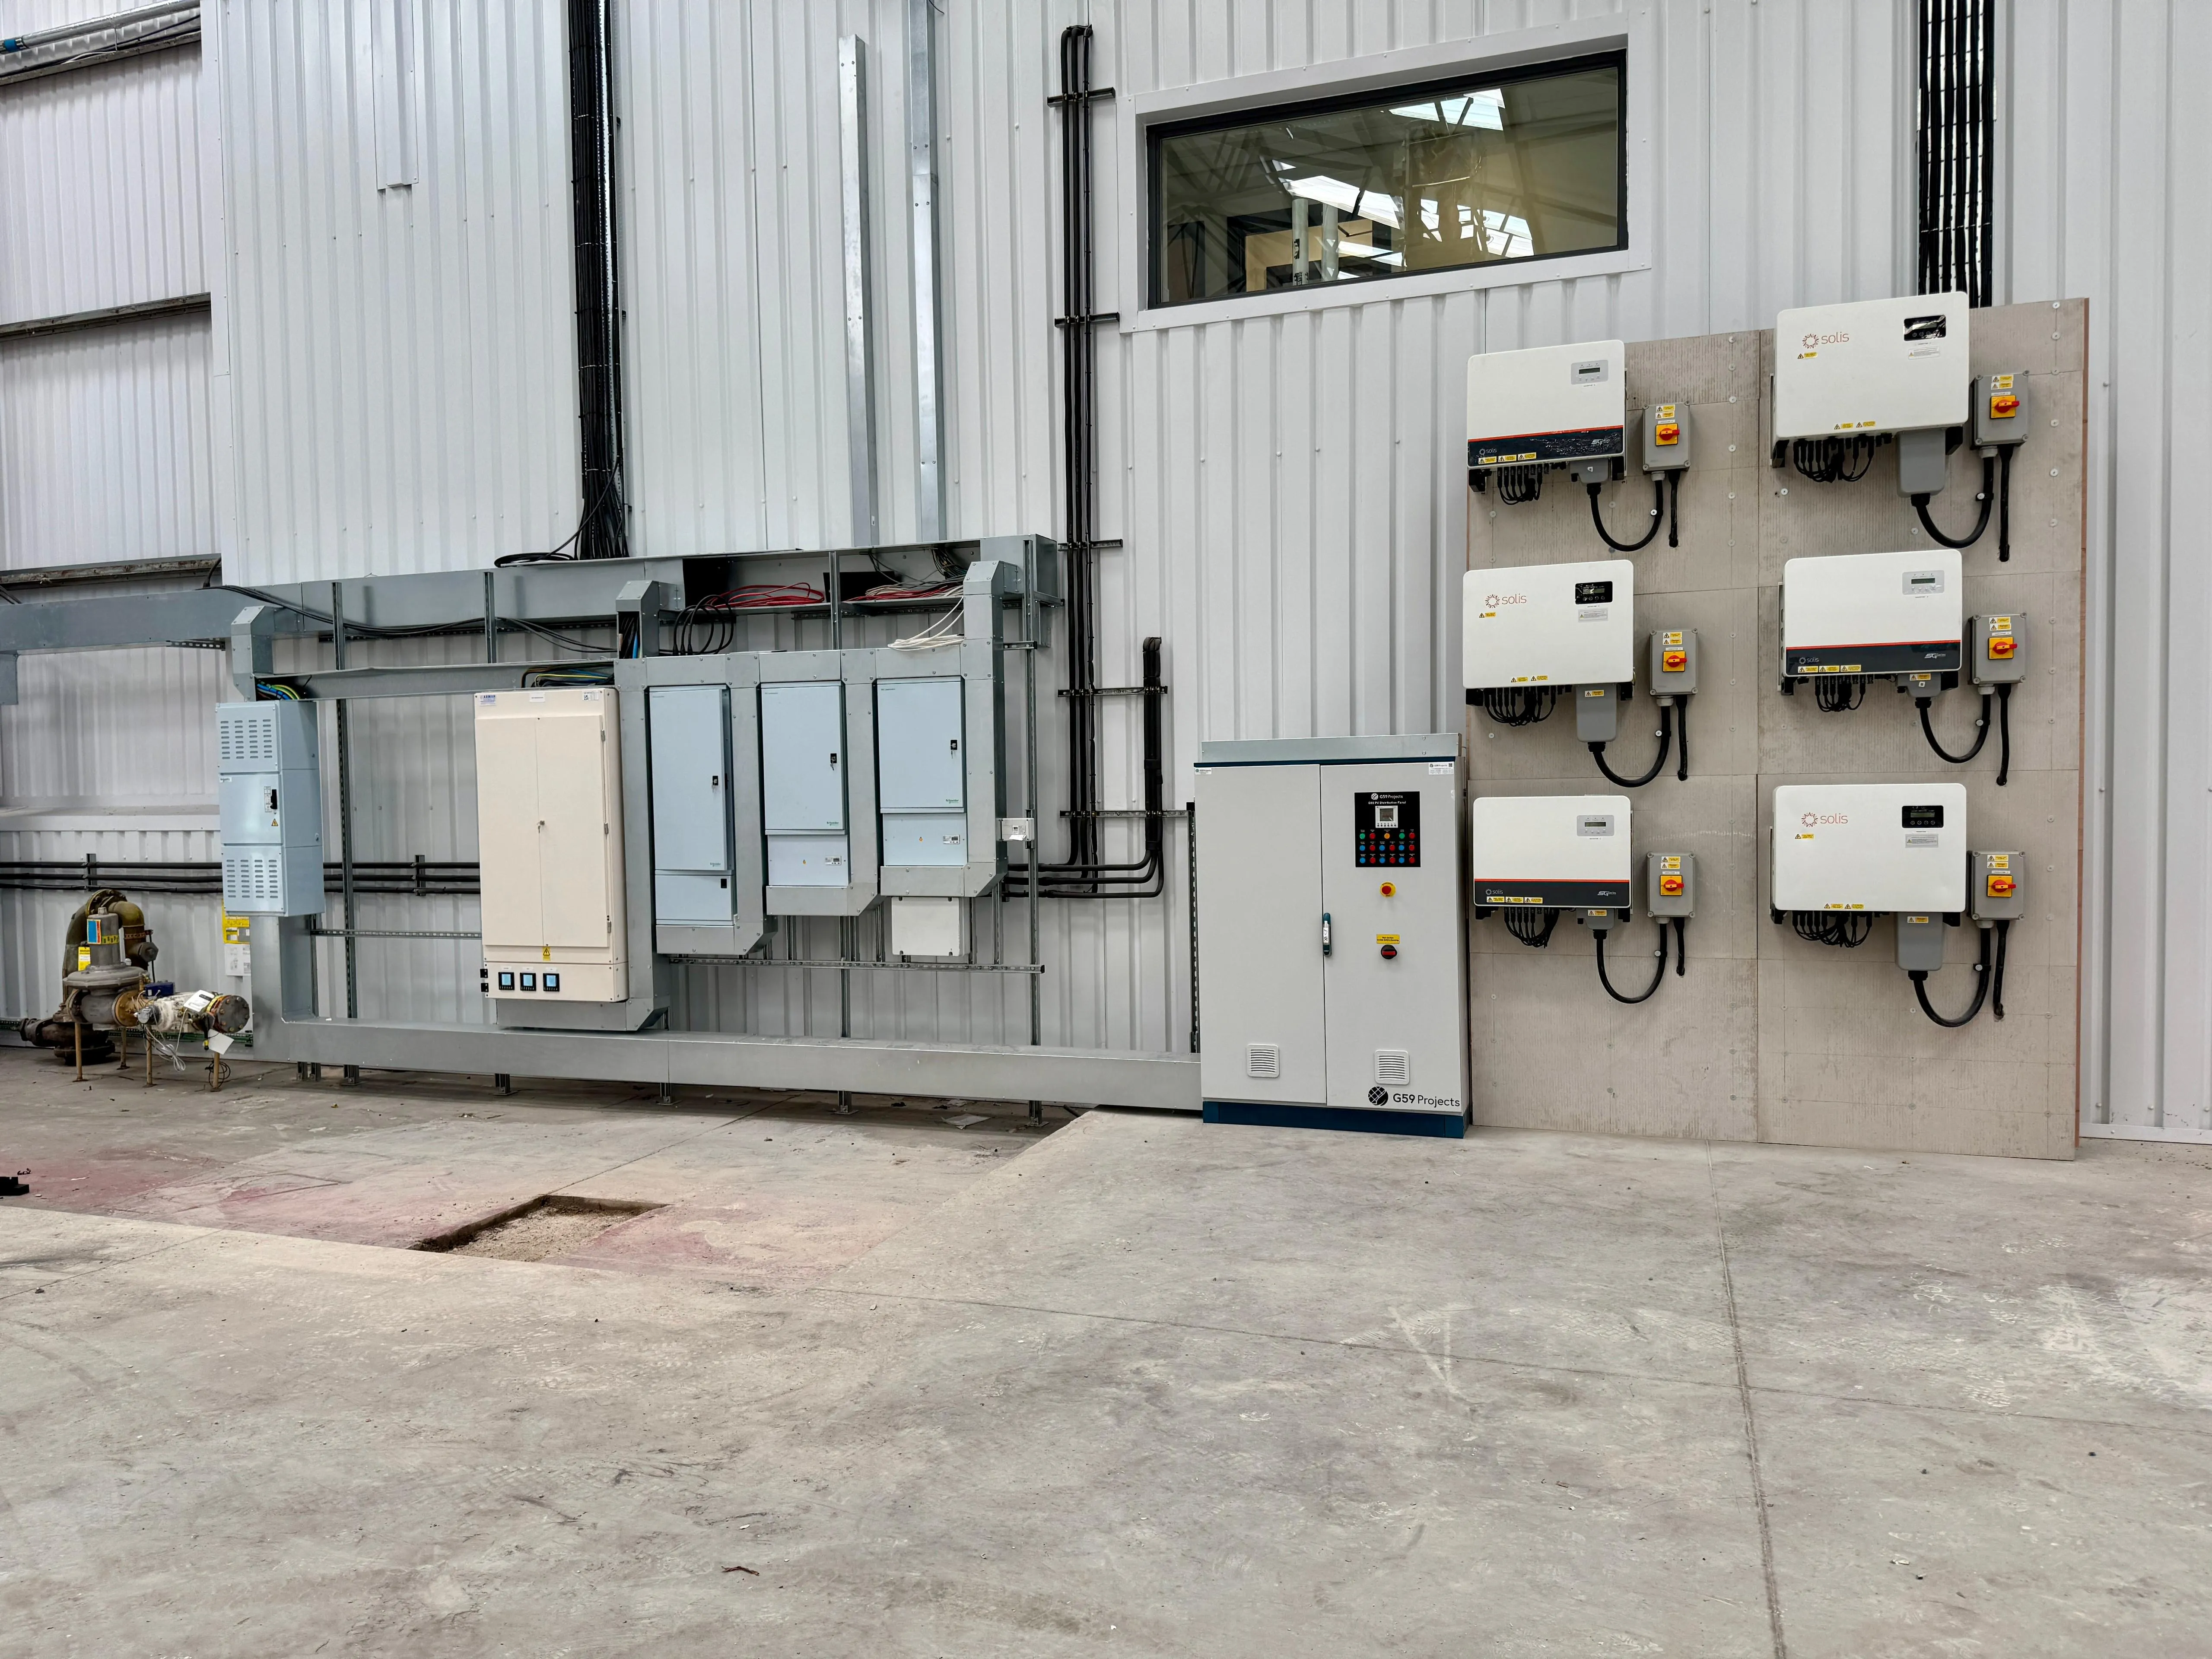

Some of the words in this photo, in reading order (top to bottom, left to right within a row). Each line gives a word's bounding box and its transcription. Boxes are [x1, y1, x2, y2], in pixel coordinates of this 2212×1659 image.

[1821, 331, 1850, 344] solis
[1501, 593, 1527, 605] solis
[1820, 813, 1848, 824] solis
[1393, 1093, 1415, 1104] G59
[1417, 1094, 1460, 1108] Projects
